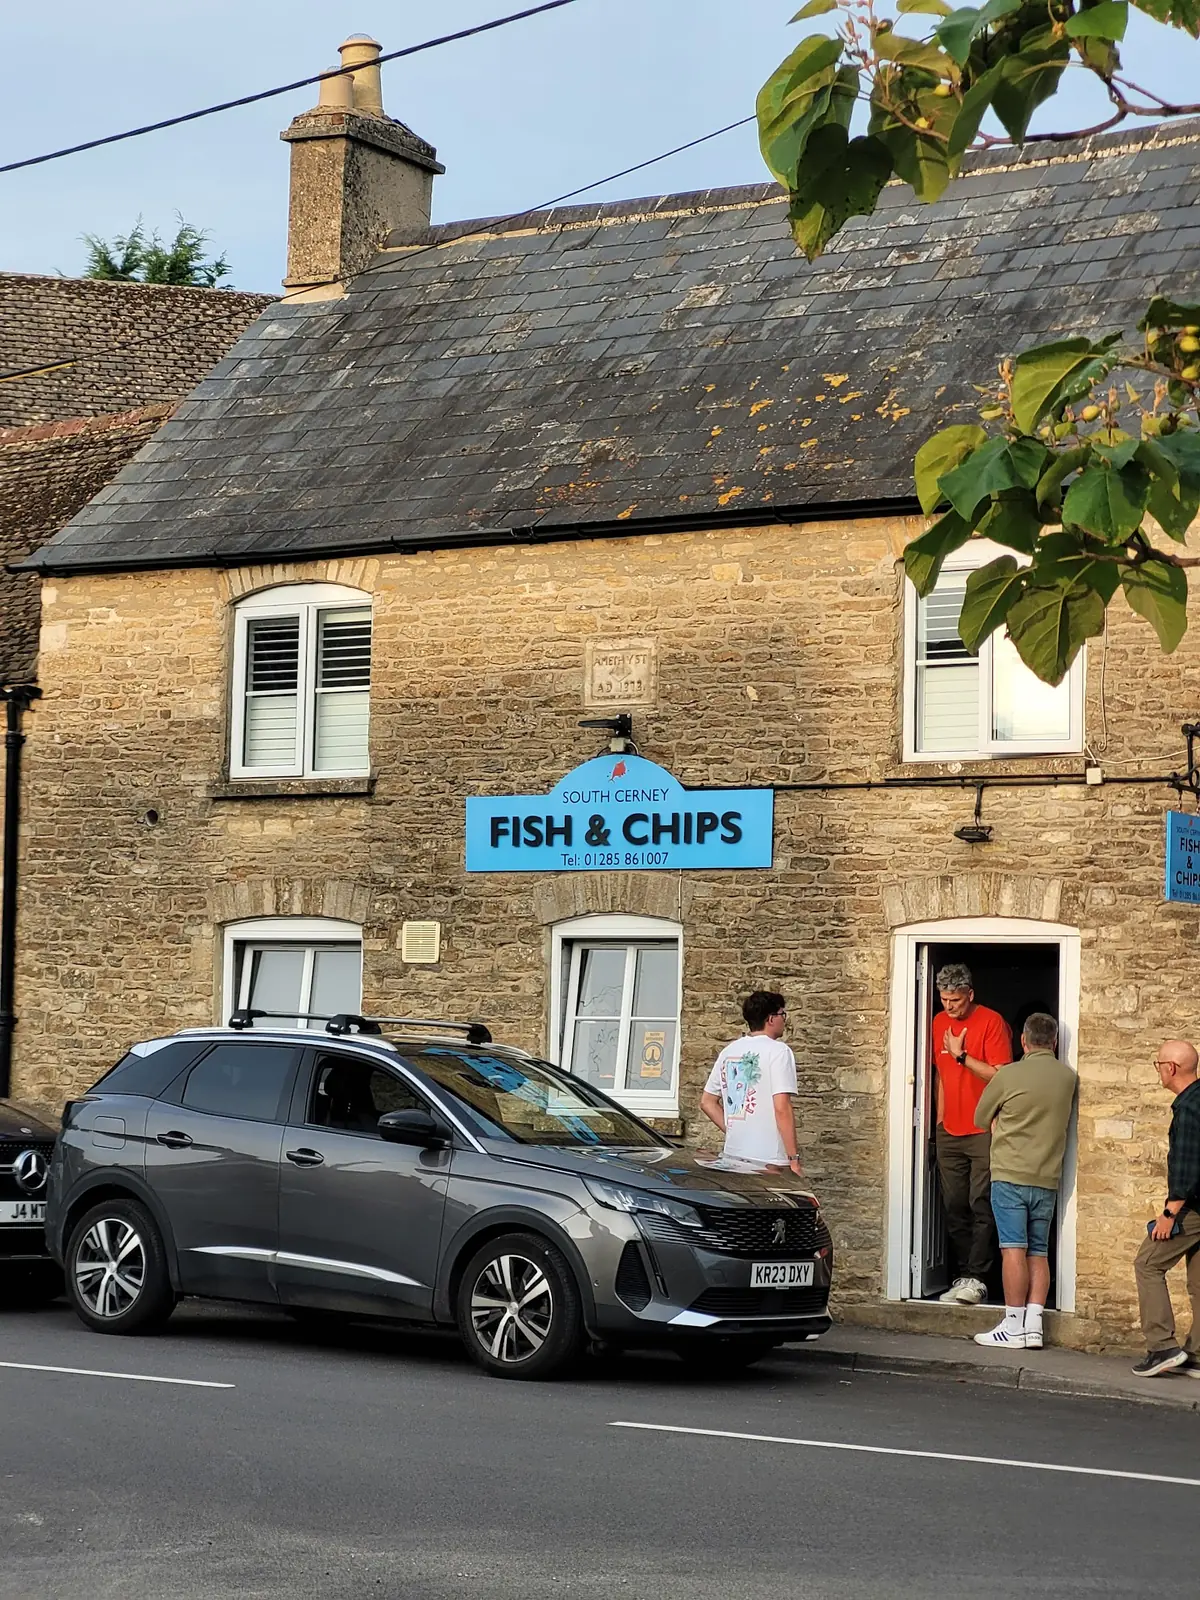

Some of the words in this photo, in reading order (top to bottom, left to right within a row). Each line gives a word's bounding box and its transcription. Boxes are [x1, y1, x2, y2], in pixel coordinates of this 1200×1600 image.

[562, 790, 610, 804] SOUTH
[614, 788, 669, 803] CERNEY
[490, 814, 573, 848] FISH
[584, 813, 611, 847] &
[622, 811, 743, 846] CHIPS
[1180, 837, 1200, 853] FISH
[560, 853, 580, 866] Tel:
[584, 852, 620, 866] 01285
[624, 852, 669, 865] 861007
[1186, 855, 1193, 869] &
[11, 1203, 27, 1219] J4
[756, 1265, 786, 1284] KR23
[789, 1264, 810, 1283] DXY
